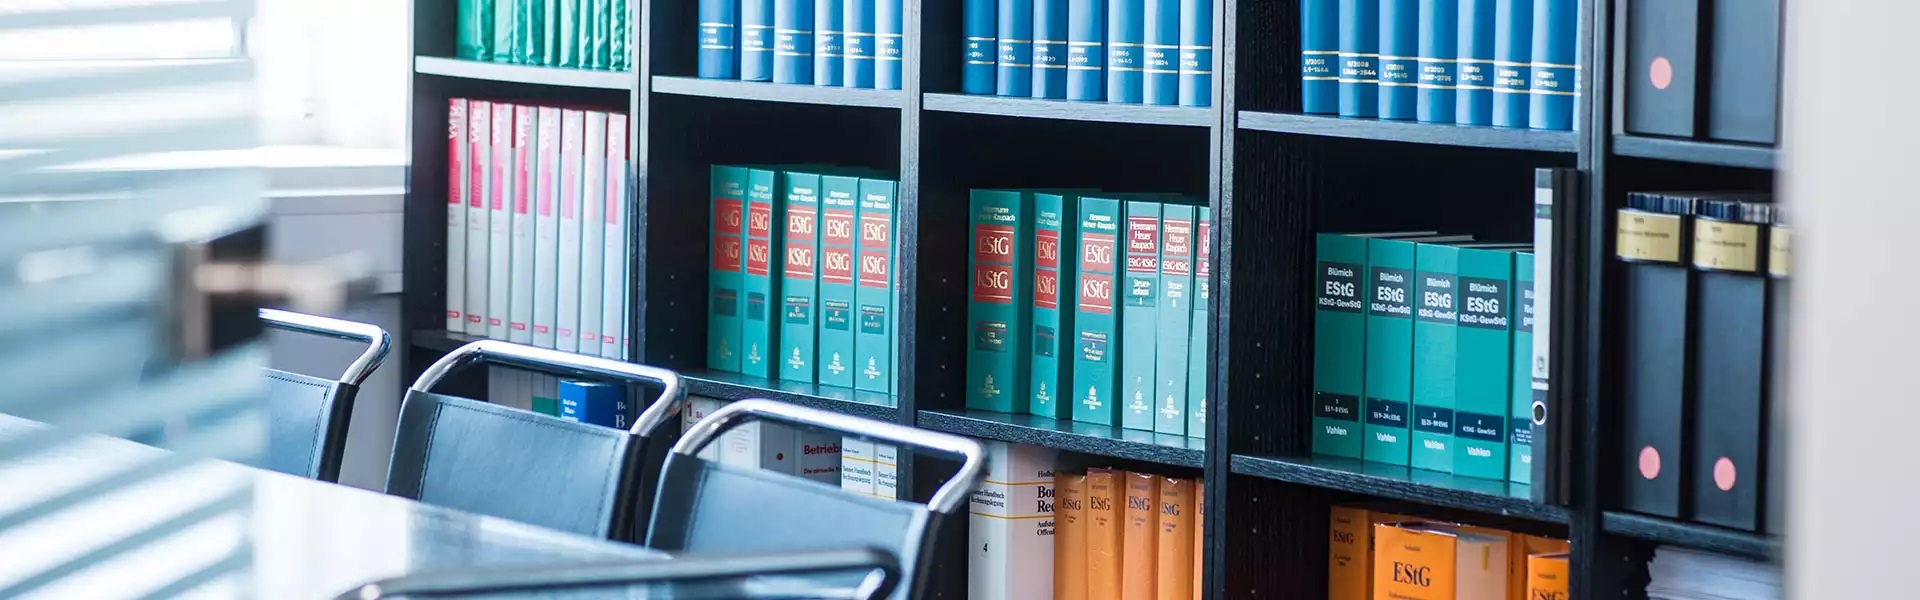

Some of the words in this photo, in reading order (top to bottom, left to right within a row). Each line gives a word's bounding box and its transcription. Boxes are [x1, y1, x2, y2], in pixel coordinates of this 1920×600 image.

[751, 209, 768, 231] EStG
[789, 215, 812, 234] EStG
[827, 219, 850, 238] EStG
[864, 223, 886, 242] EStG
[1134, 231, 1151, 240] Heuer
[978, 236, 1009, 256] EStG
[1131, 240, 1155, 252] Raupach
[1169, 233, 1185, 243] Heuer
[788, 247, 811, 267] KStG
[1037, 241, 1056, 260] EStG
[1085, 244, 1111, 264] EStG
[826, 251, 849, 271] KStG
[862, 255, 886, 275] KStG
[977, 270, 1009, 289] KStG
[1327, 266, 1354, 278] Blümich
[1379, 271, 1404, 283] Blümich
[1036, 275, 1056, 295] KStG
[1083, 279, 1110, 300] KStG
[1325, 281, 1355, 297] EStG
[1426, 277, 1450, 288] Blümich
[1469, 282, 1498, 293] Blümich
[1377, 286, 1405, 303] EStG
[1424, 291, 1451, 308] EStG
[1467, 296, 1499, 314] EStG
[1325, 425, 1348, 436] Vahlen
[1376, 432, 1397, 443] Vahlen
[803, 442, 840, 455] Betrieb
[1423, 439, 1445, 450] Vahlen
[1466, 446, 1491, 457] Vahlen
[1062, 497, 1082, 511] EStG
[1090, 496, 1111, 511] EStG
[1128, 495, 1151, 512] EStG
[1161, 503, 1180, 516] EStG
[1333, 530, 1354, 545] EStG
[983, 542, 989, 553] 4
[1393, 561, 1431, 587] EStG
